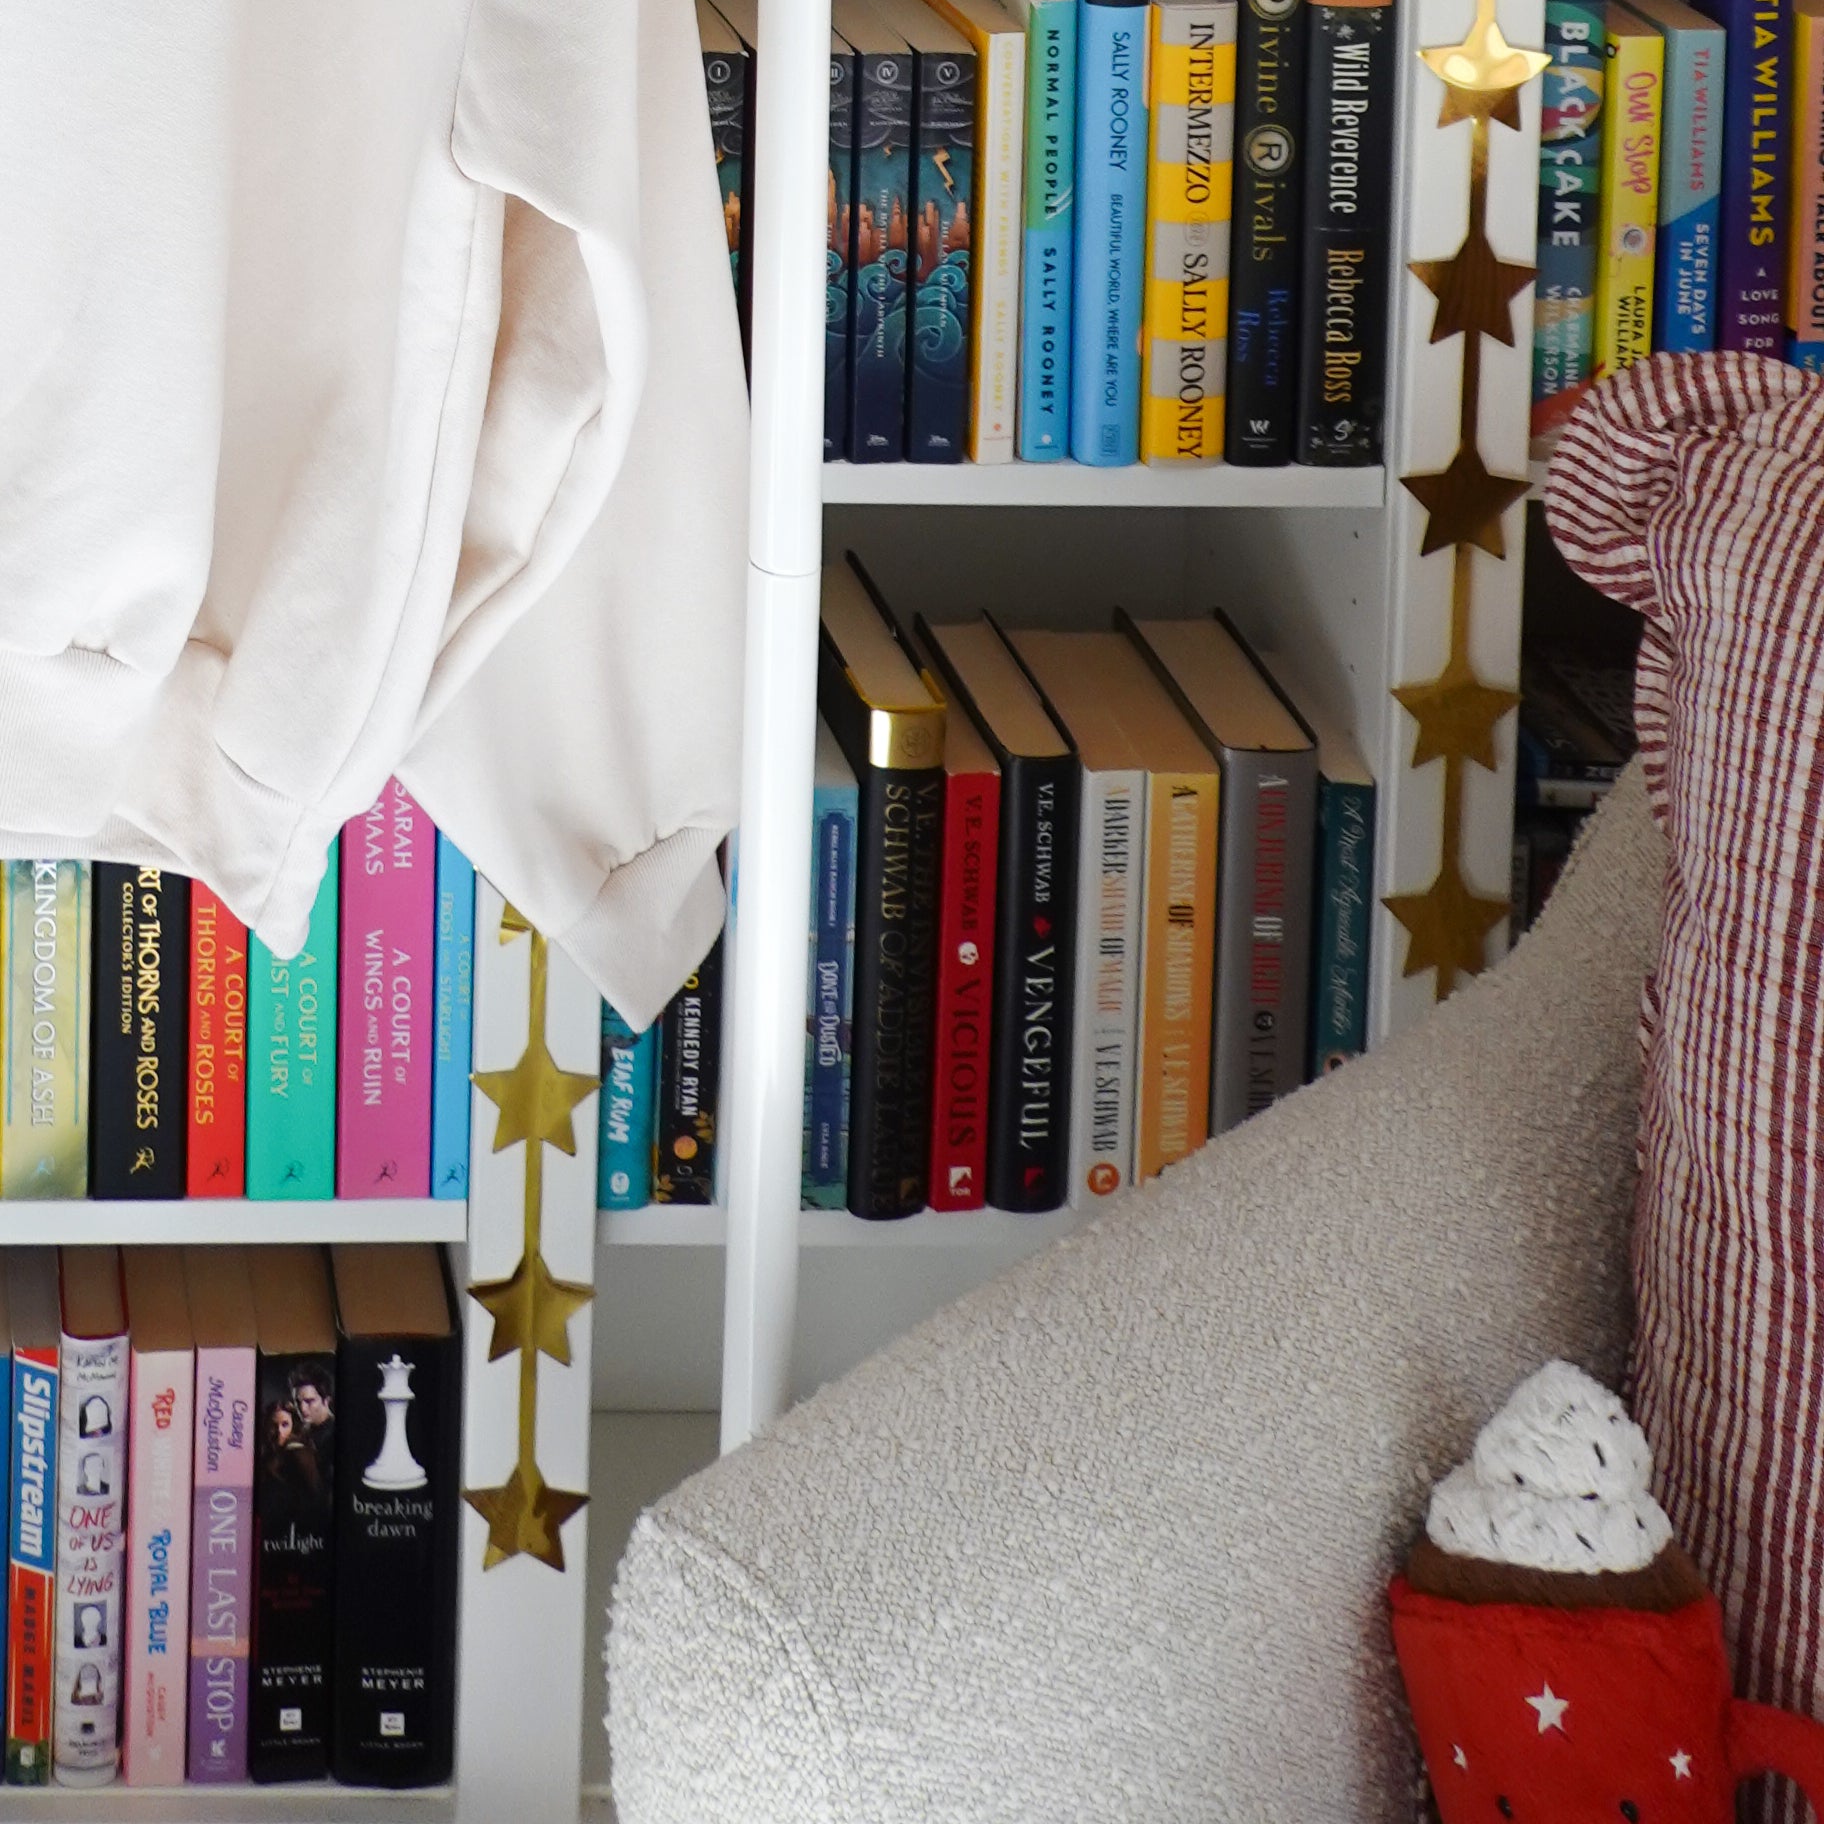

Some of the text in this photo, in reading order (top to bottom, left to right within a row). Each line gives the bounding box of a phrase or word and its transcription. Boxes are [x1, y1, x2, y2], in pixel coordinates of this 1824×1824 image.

[1553, 22, 1589, 248] BLACK CAKE
[1749, 54, 1778, 249] WILLIAMS
[1179, 22, 1213, 460] INTERMEZZO SALLY ROONEY
[680, 996, 702, 1117] KENNEDY RYAN
[1021, 943, 1057, 1150] VENGEFUL
[20, 1374, 52, 1556] Slipstream
[353, 1495, 433, 1521] breaking
[368, 1520, 416, 1538] dawn
[205, 1490, 238, 1730] ONE LAST STOP
